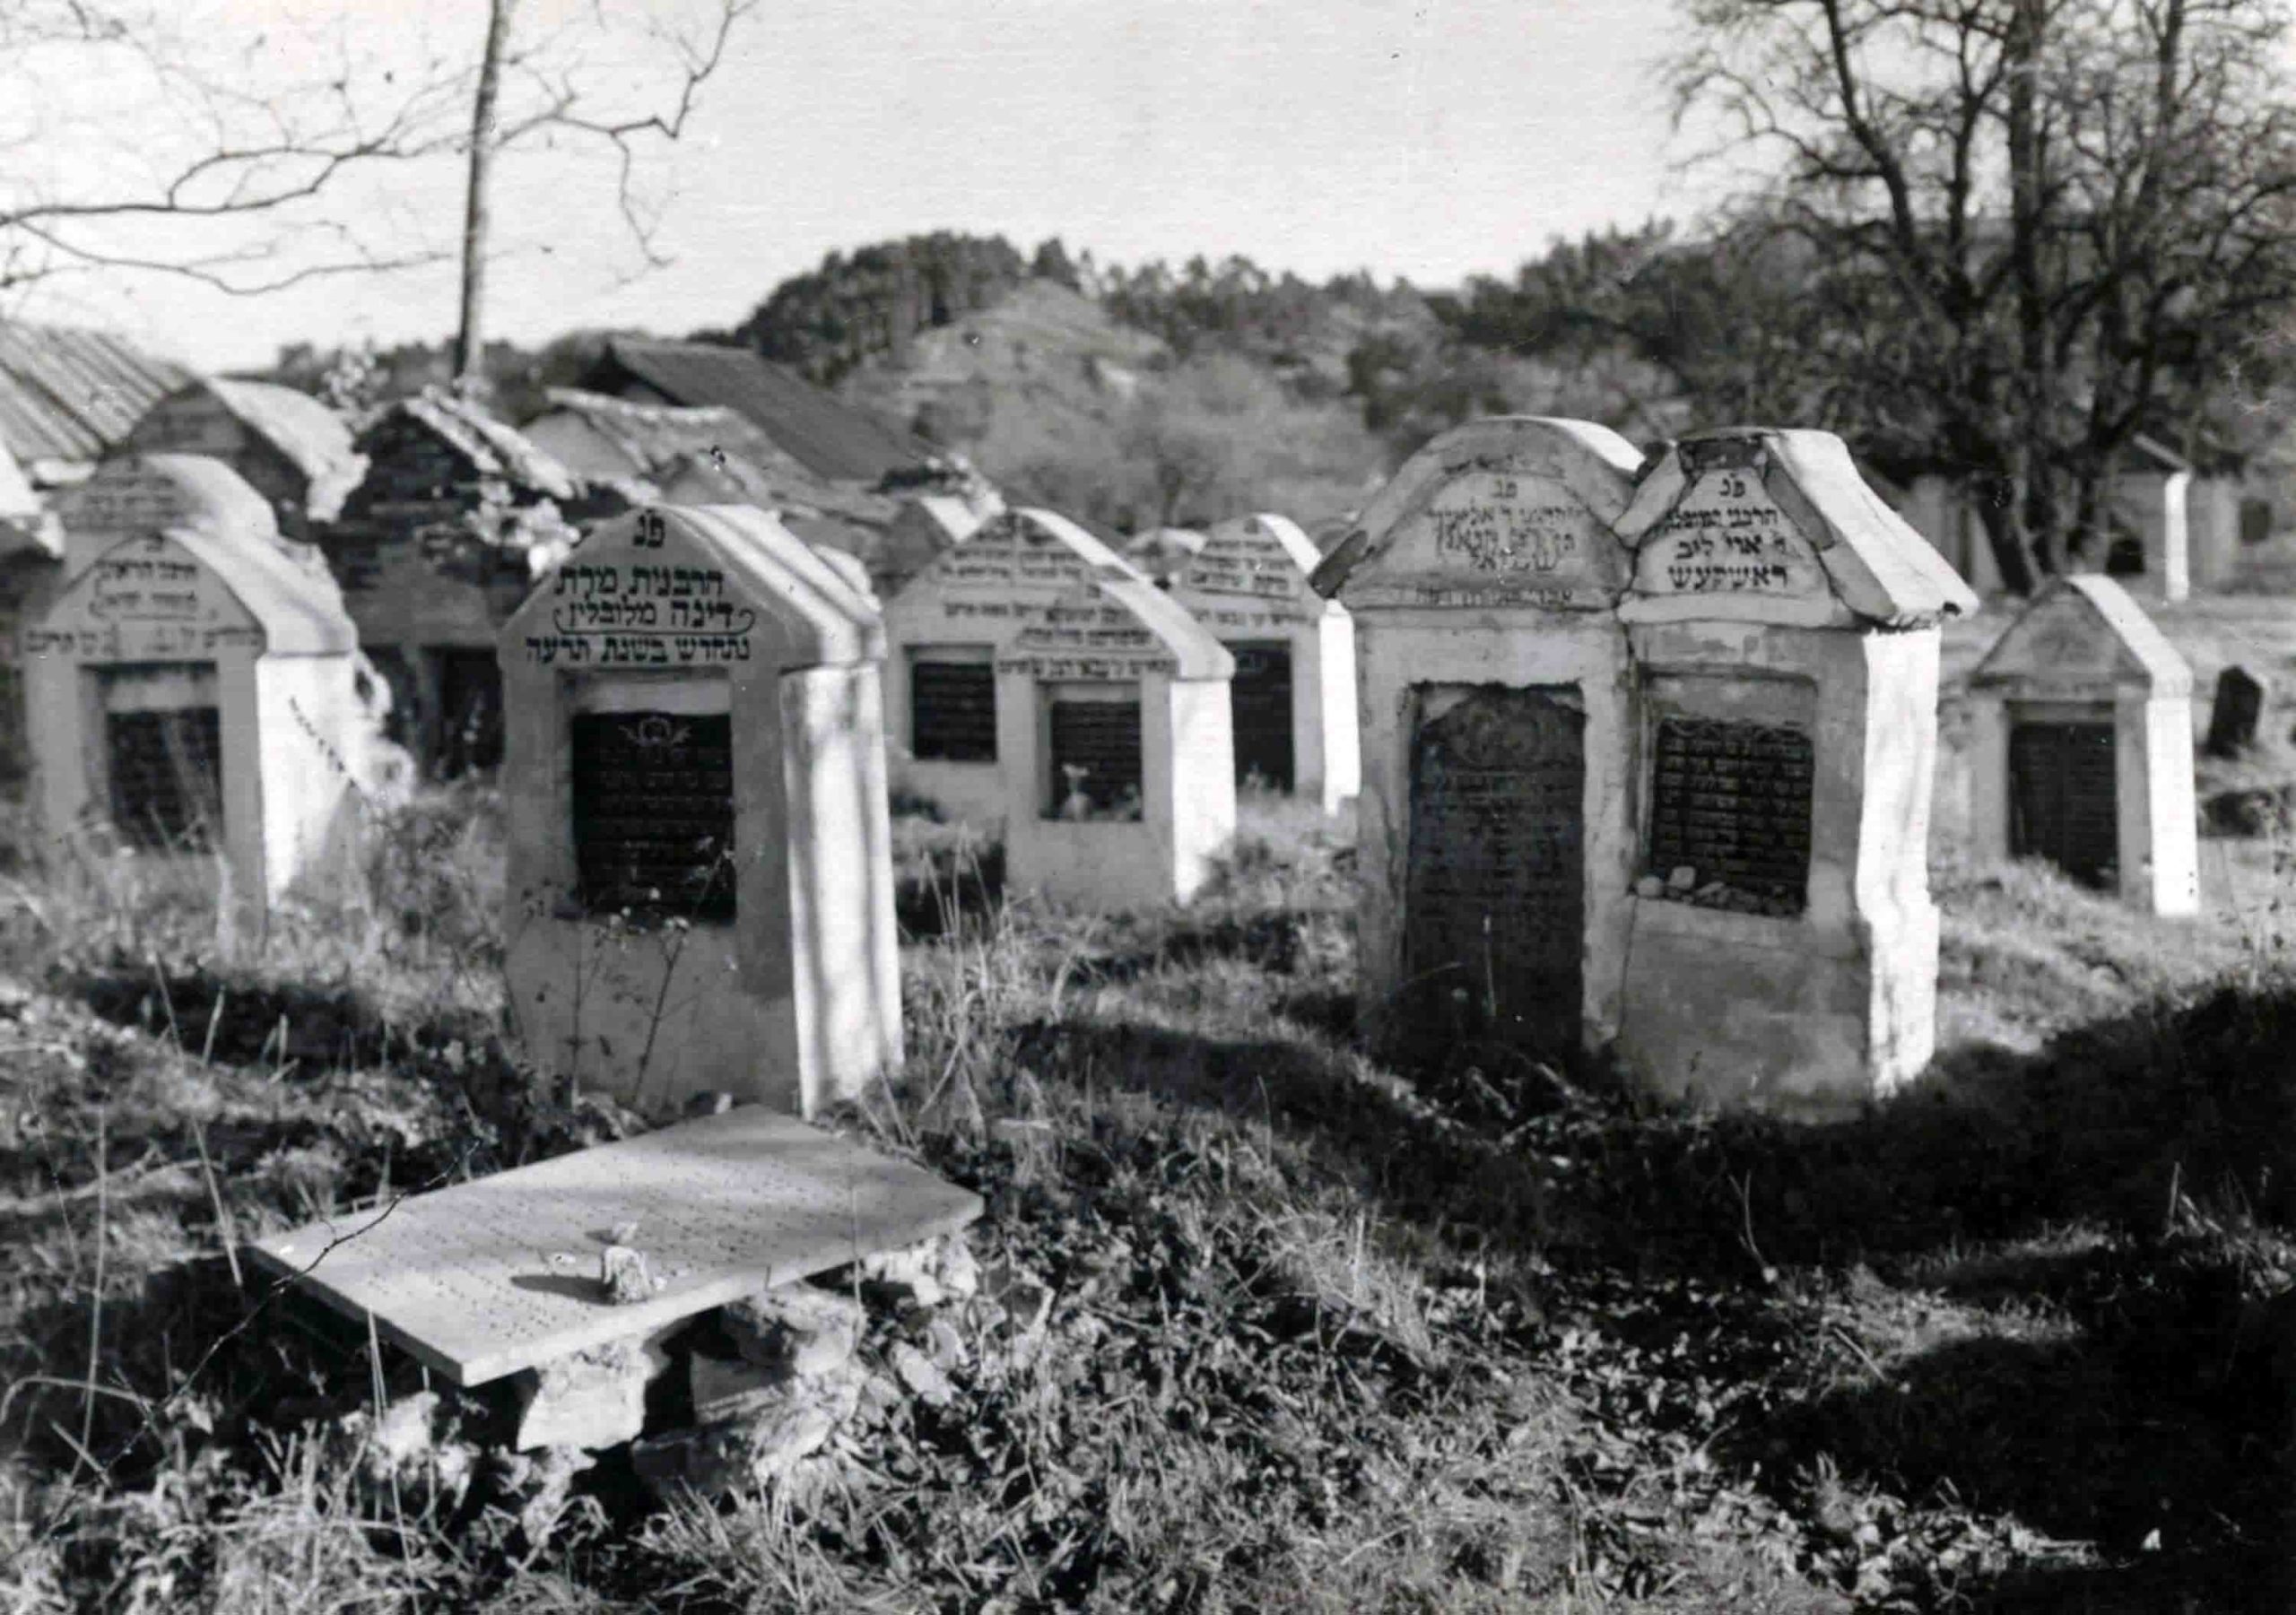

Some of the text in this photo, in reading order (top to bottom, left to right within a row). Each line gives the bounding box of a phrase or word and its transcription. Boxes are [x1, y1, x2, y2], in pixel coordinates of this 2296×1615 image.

[553, 565, 725, 596] הרבנית מרת
[670, 599, 735, 628] דינה
[600, 636, 668, 663] בשנת
